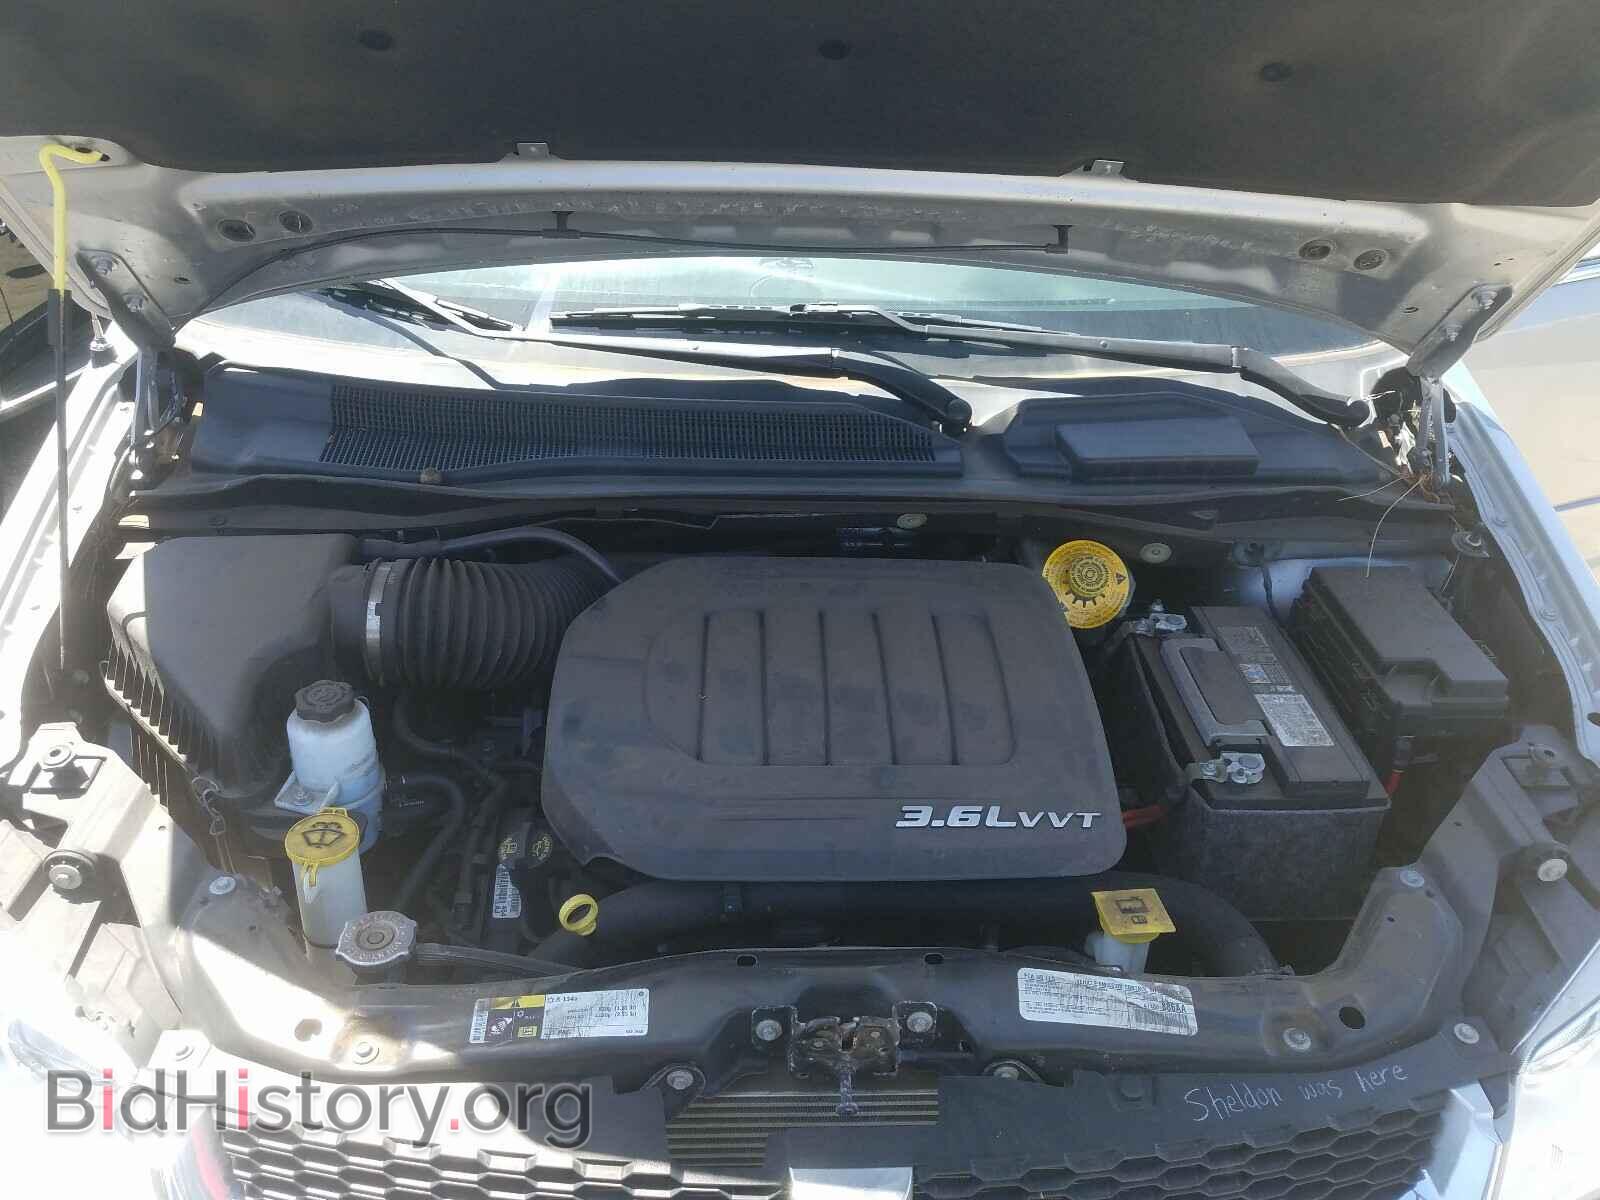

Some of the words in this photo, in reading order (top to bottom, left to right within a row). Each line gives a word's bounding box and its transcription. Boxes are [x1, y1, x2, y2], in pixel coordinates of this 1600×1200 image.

[1184, 1083, 1283, 1122] Sheldon
[1298, 1079, 1344, 1101] was
[1352, 1063, 1409, 1093] here
